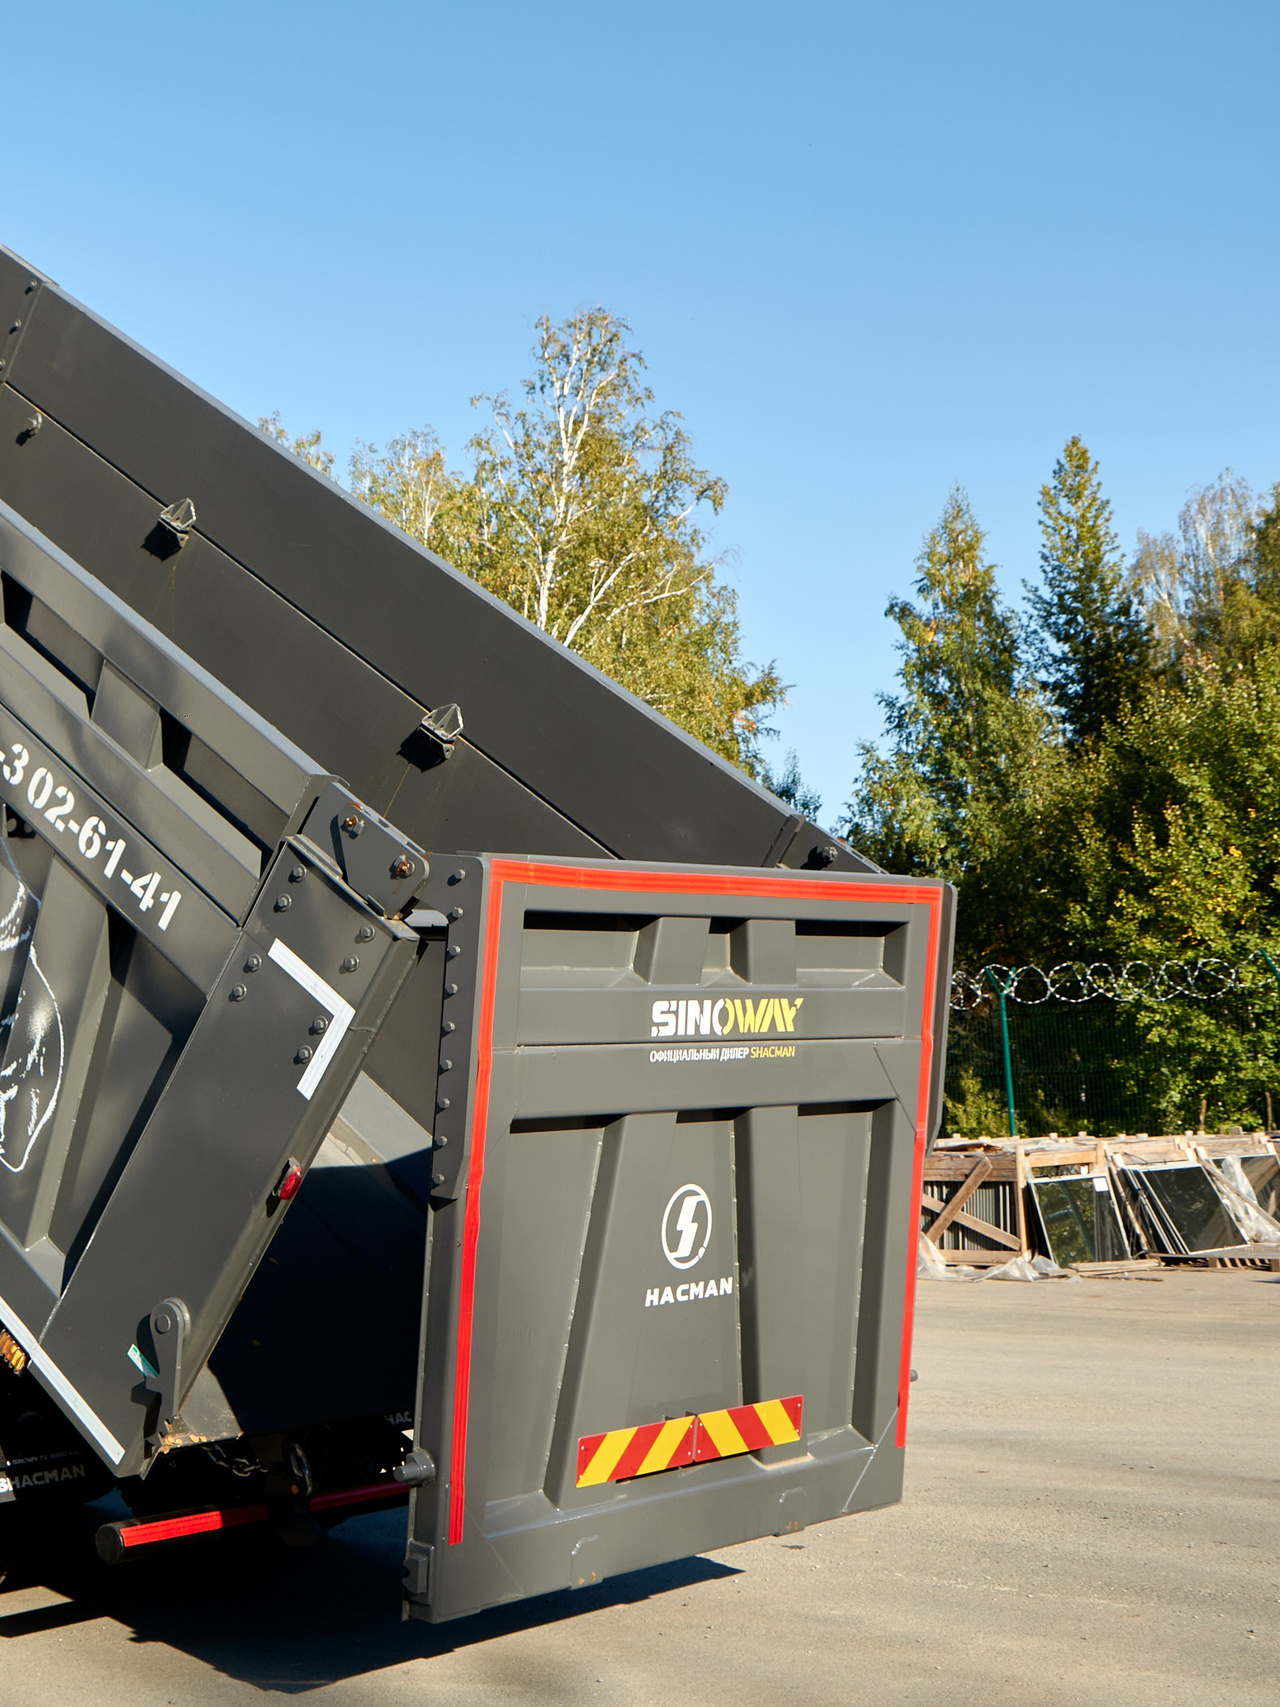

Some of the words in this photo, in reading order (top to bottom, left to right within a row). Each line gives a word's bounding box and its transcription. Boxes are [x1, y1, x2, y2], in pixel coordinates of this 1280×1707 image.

[651, 997, 804, 1037] SINOWAY
[720, 1047, 749, 1062] ДИЛЕР
[750, 1045, 796, 1059] SHACMAN
[644, 1276, 734, 1307] HACMAN
